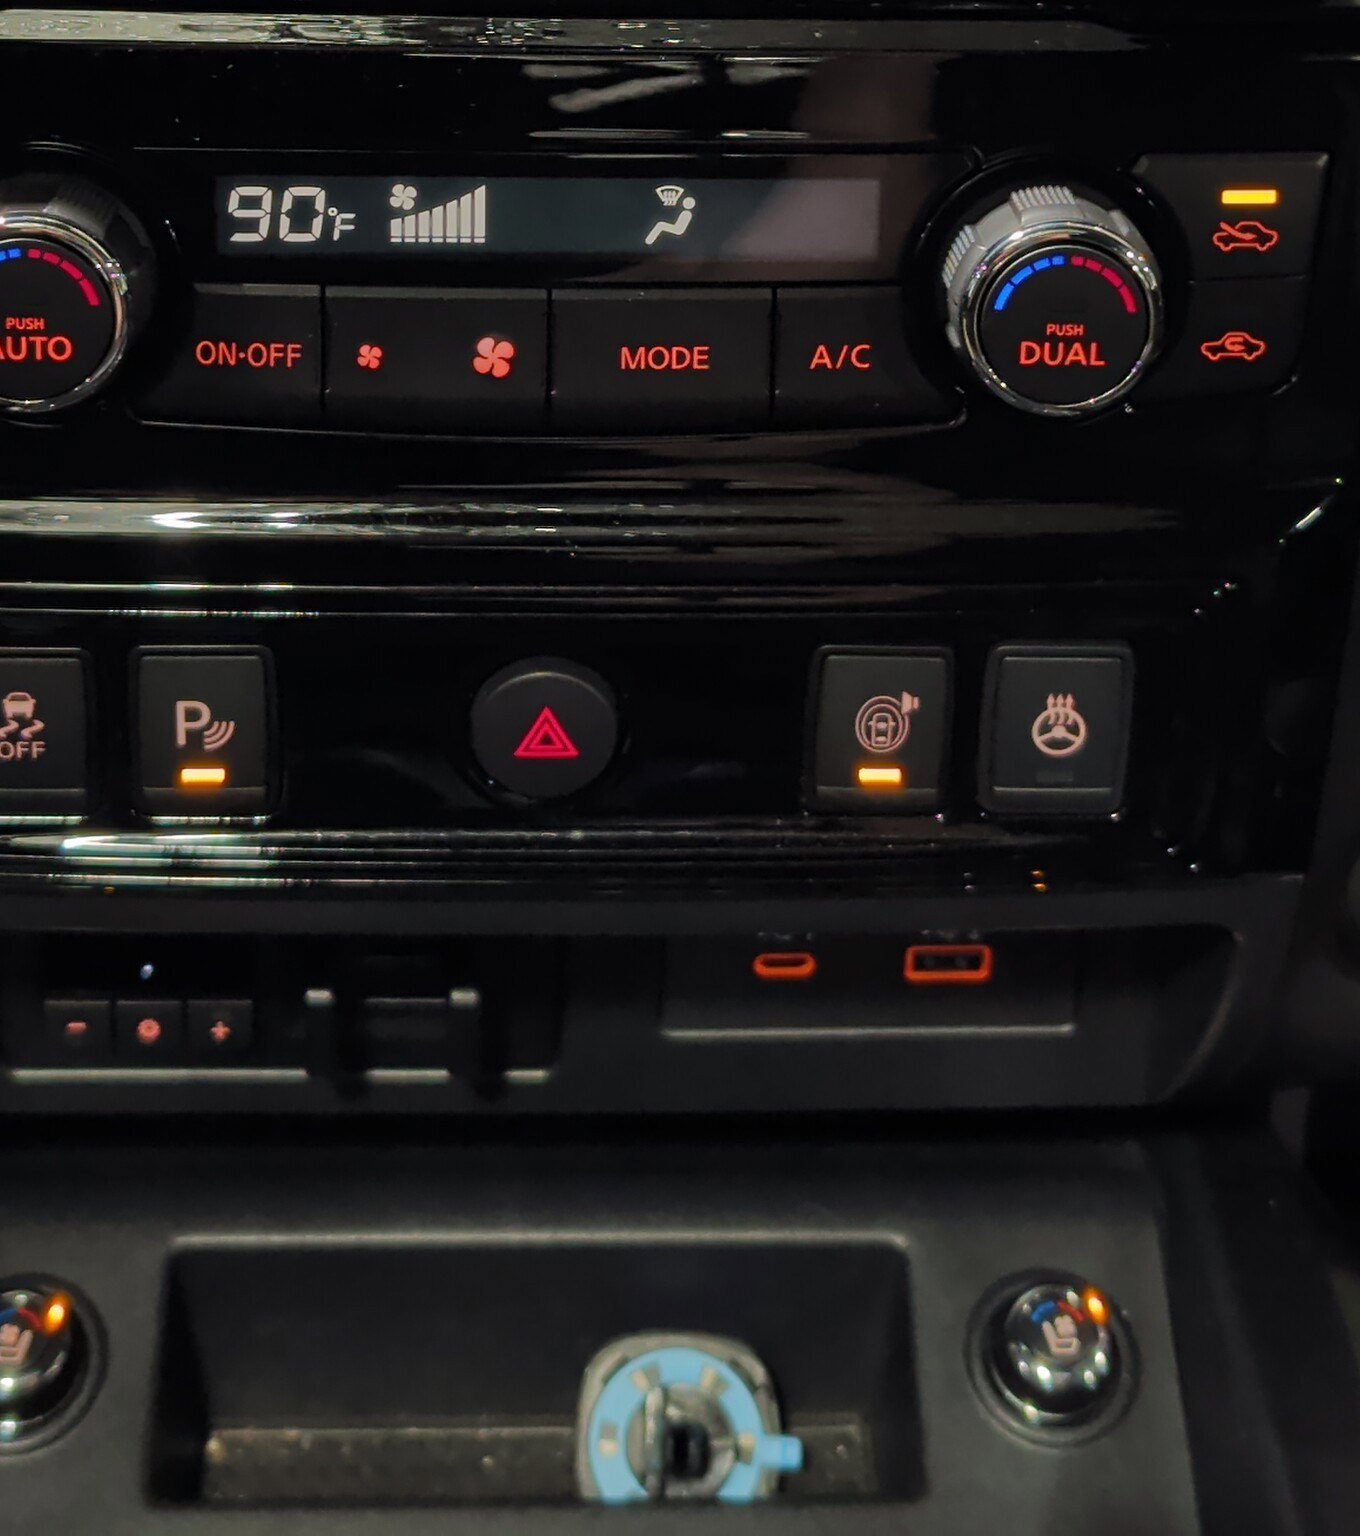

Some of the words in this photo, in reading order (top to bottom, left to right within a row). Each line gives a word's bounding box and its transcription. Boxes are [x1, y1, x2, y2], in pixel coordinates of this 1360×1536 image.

[6, 316, 45, 331] PUSH
[1046, 323, 1084, 337] PUSH
[619, 346, 710, 372] MODE
[808, 344, 871, 372] A/C
[1018, 340, 1105, 367] DUAL
